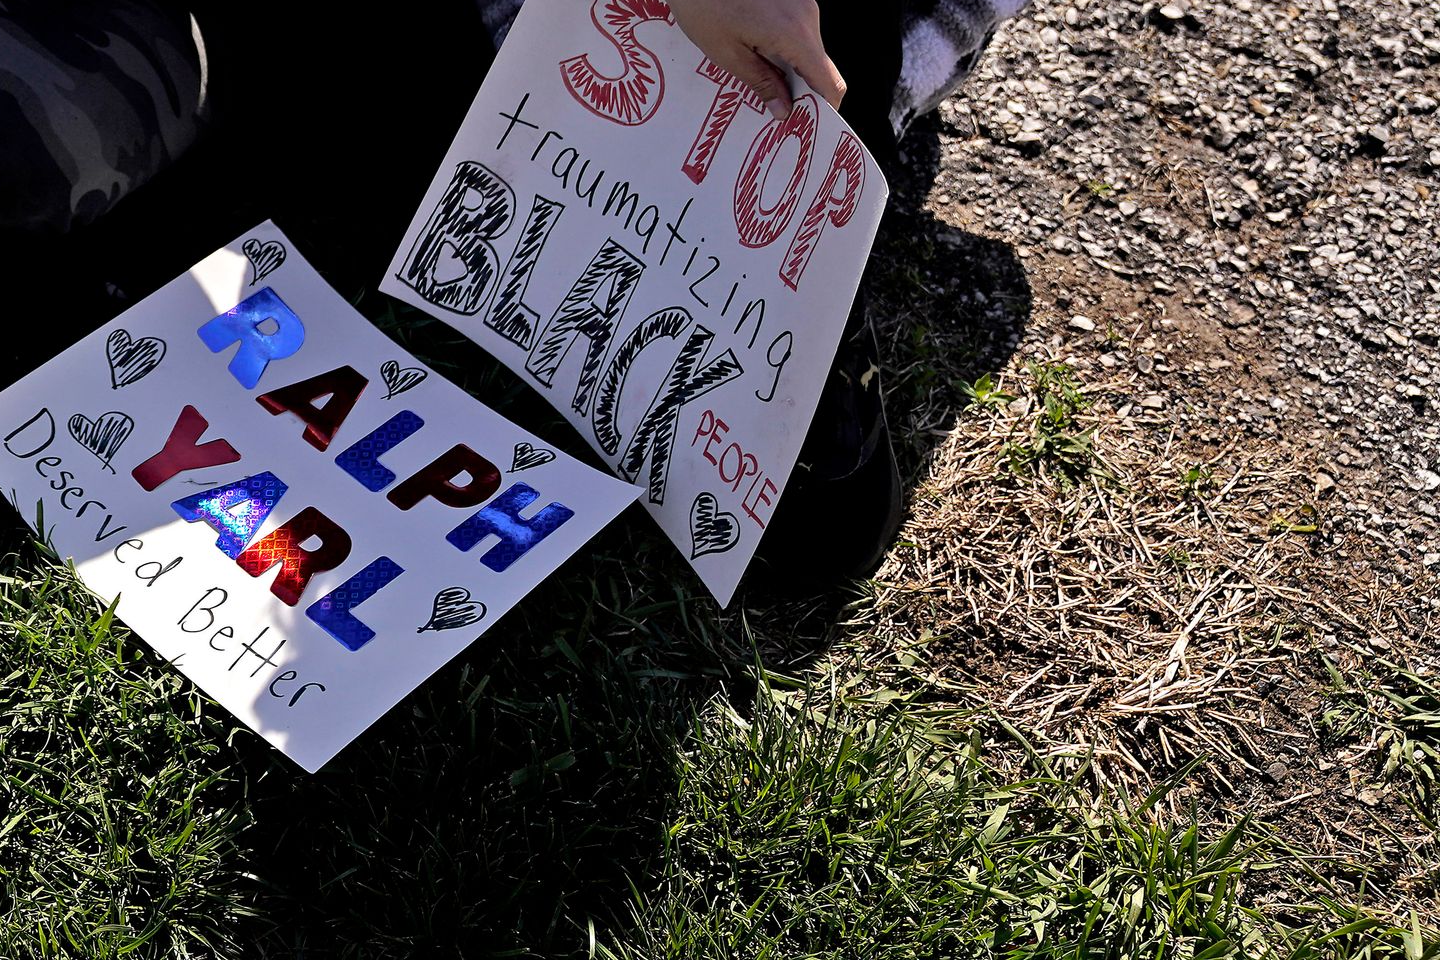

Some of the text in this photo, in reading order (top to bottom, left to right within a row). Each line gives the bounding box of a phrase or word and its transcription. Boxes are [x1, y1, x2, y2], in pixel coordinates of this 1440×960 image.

[395, 160, 745, 506] BLACK
[498, 92, 795, 403] traumatizing
[2, 407, 327, 709] Deserved Better
[130, 404, 407, 653] YARL
[196, 285, 576, 573] RALPH
[690, 409, 779, 529] PEOPLE
